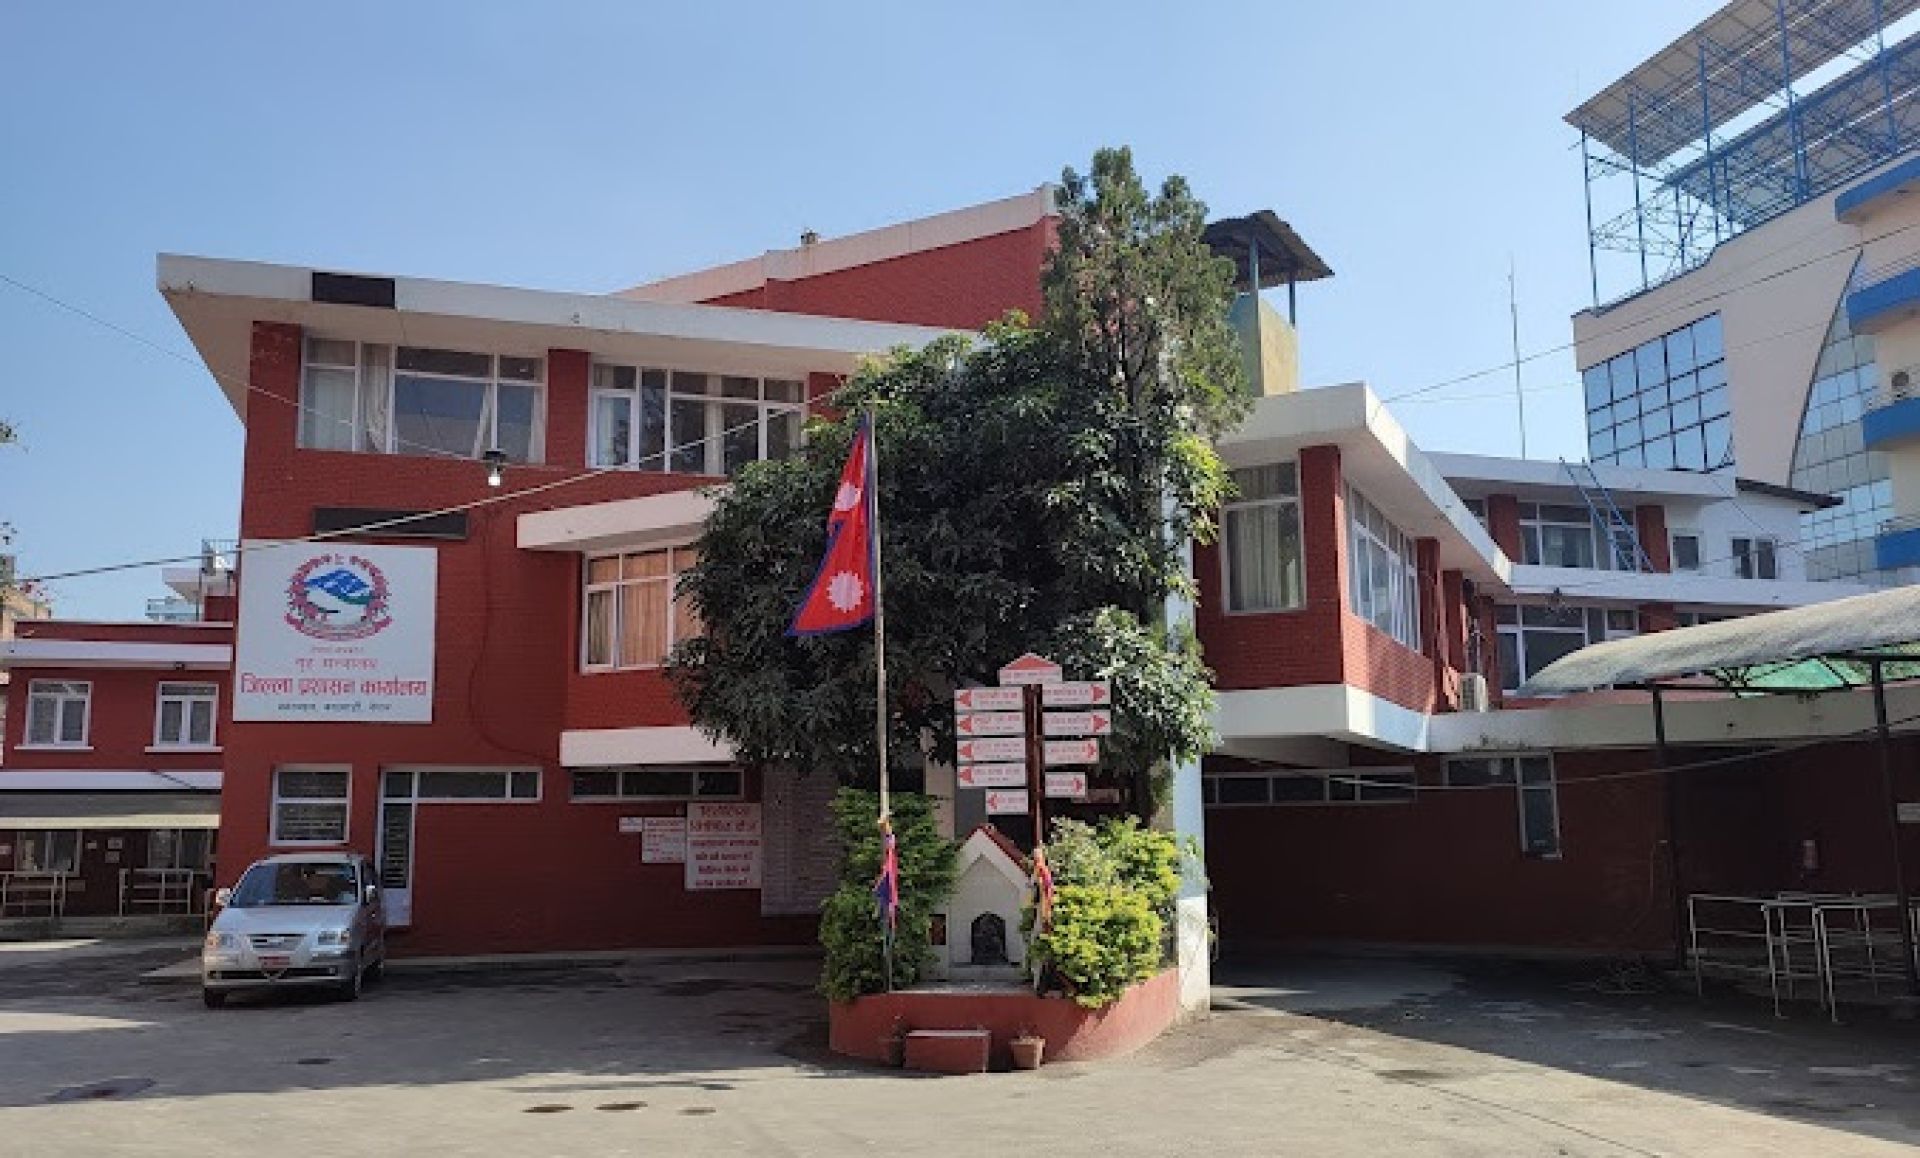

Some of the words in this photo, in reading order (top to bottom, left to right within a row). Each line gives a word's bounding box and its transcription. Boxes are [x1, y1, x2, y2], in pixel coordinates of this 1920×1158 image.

[241, 672, 293, 696] जिल्ला
[298, 677, 356, 697] प्रशासन
[360, 675, 427, 697] कार्यालय
